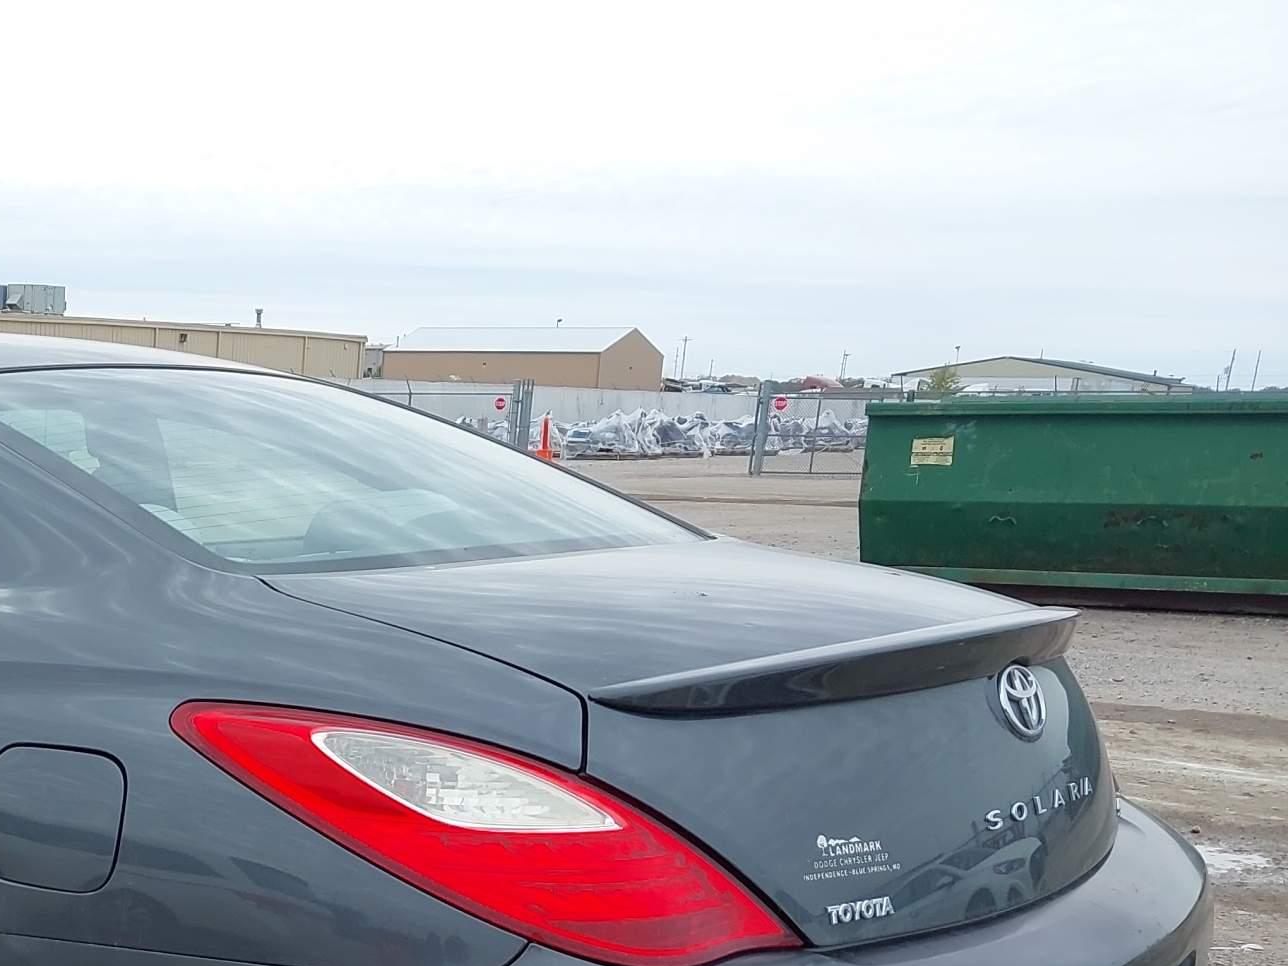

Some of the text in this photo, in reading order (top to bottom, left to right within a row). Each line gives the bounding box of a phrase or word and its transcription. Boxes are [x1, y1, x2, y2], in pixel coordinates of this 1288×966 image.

[985, 777, 1093, 830] SOLARA
[829, 840, 882, 857] LANDMARK
[814, 852, 889, 869] DODGE CHRYSLER JEEP
[825, 896, 895, 925] TOYOTA
